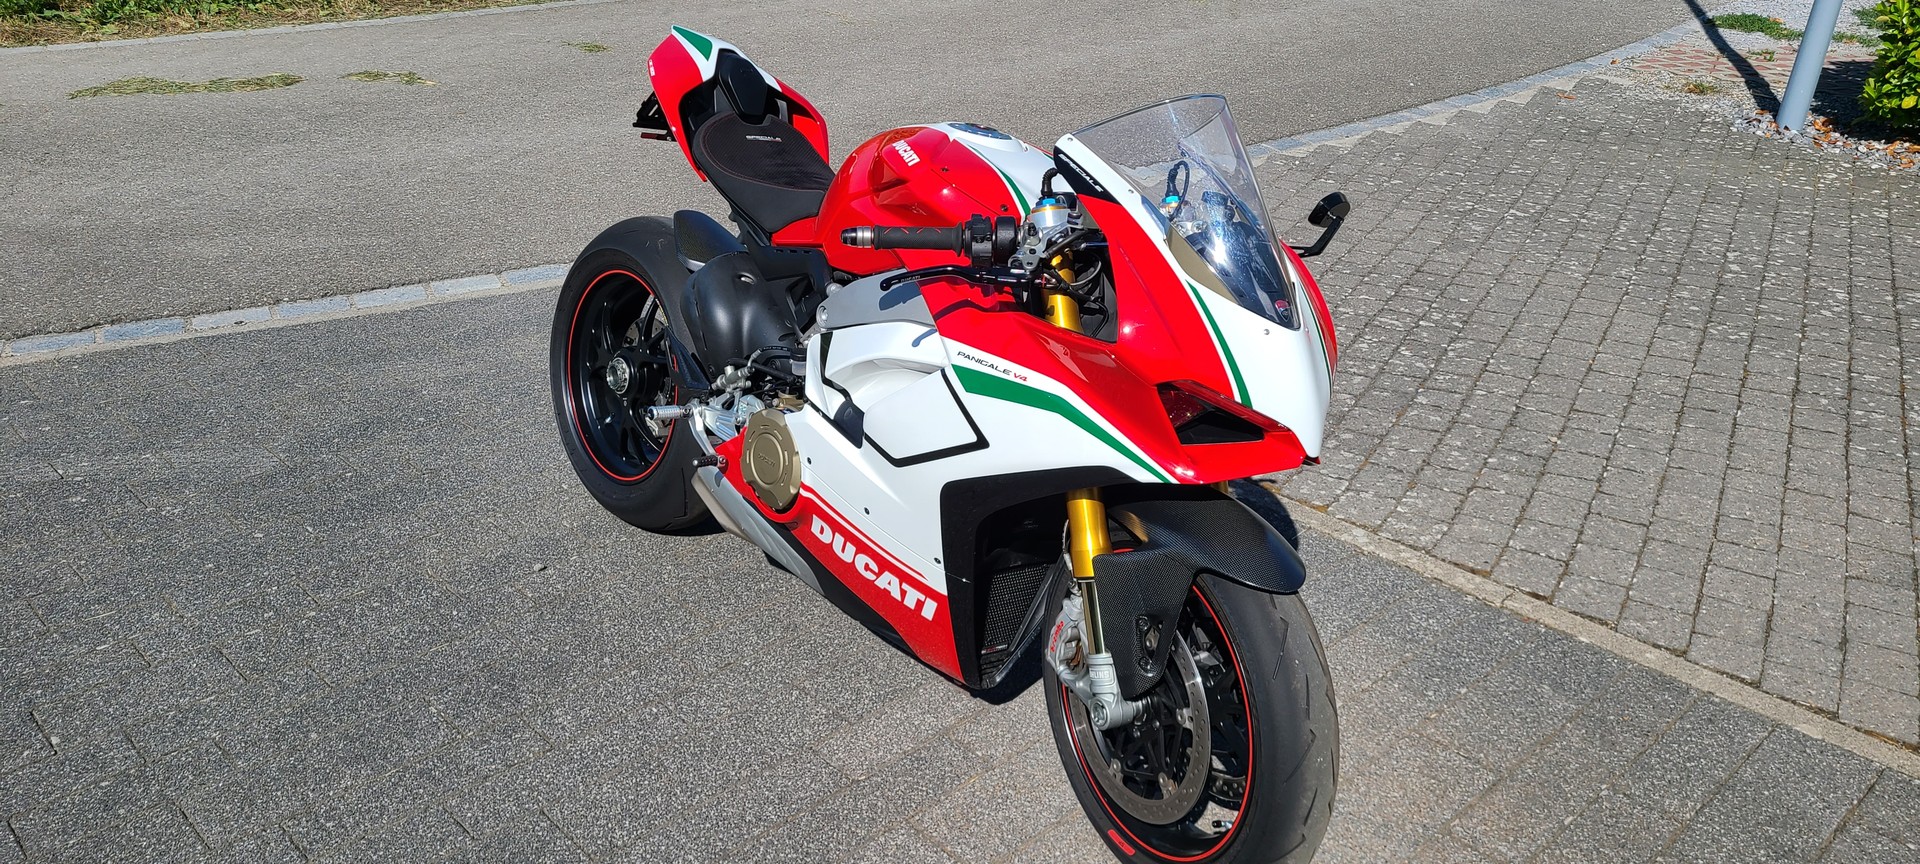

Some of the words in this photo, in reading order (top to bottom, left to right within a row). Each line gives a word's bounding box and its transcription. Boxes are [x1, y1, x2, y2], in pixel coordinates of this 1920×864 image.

[892, 140, 921, 167] DUCATI
[1058, 153, 1104, 192] SPECIALE
[957, 351, 1012, 376] PANIGALE
[1013, 372, 1028, 382] V4
[811, 514, 938, 622] DUCATI
